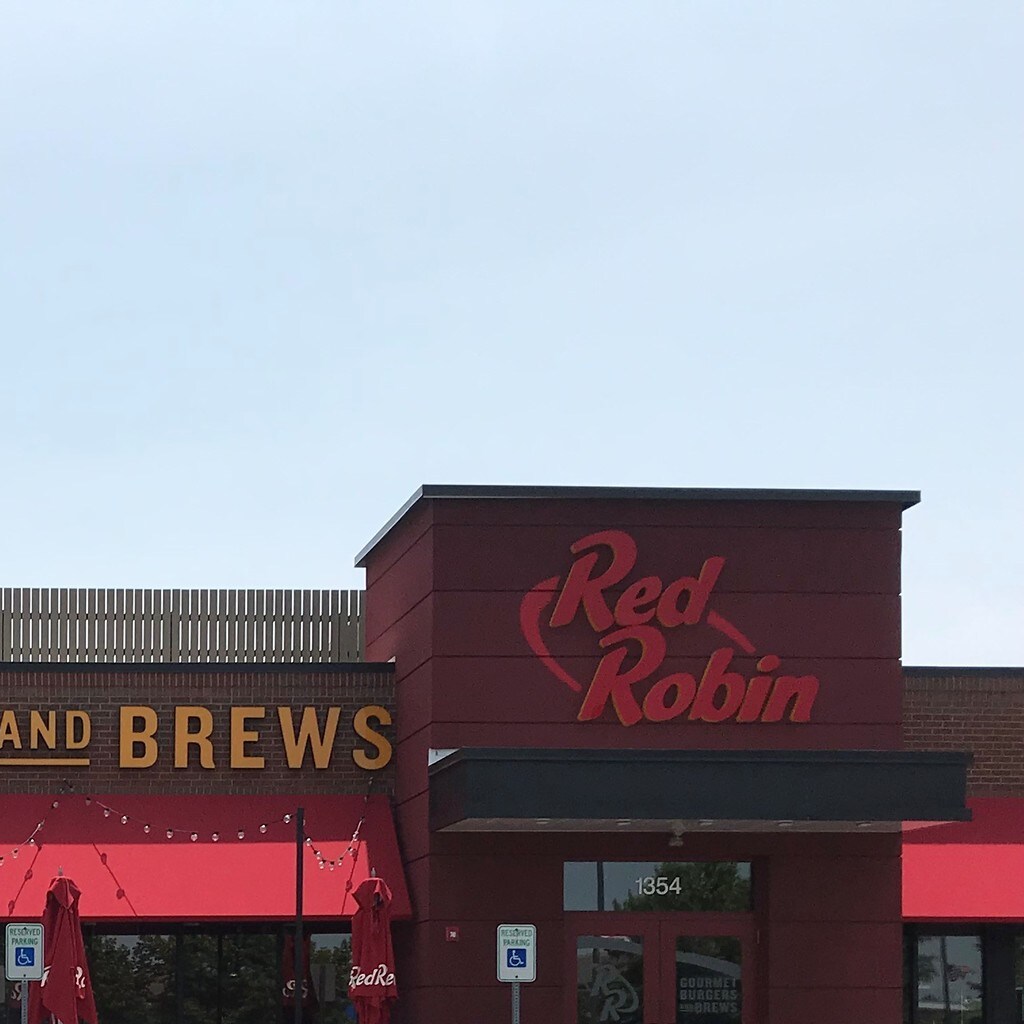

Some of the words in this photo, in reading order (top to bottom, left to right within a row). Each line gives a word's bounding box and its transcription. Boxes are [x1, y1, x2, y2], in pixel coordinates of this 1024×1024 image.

[548, 529, 726, 632] Red
[577, 623, 820, 727] Robin
[118, 704, 393, 770] BREWS
[635, 876, 682, 895] 1354
[9, 928, 41, 936] RESERVED
[500, 929, 533, 937] RESERVED
[11, 938, 38, 946] PARKING
[503, 938, 531, 947] PARKING
[679, 976, 737, 988] GOURMET
[679, 989, 738, 1000] BURGERS
[694, 1002, 738, 1013] BREWS
